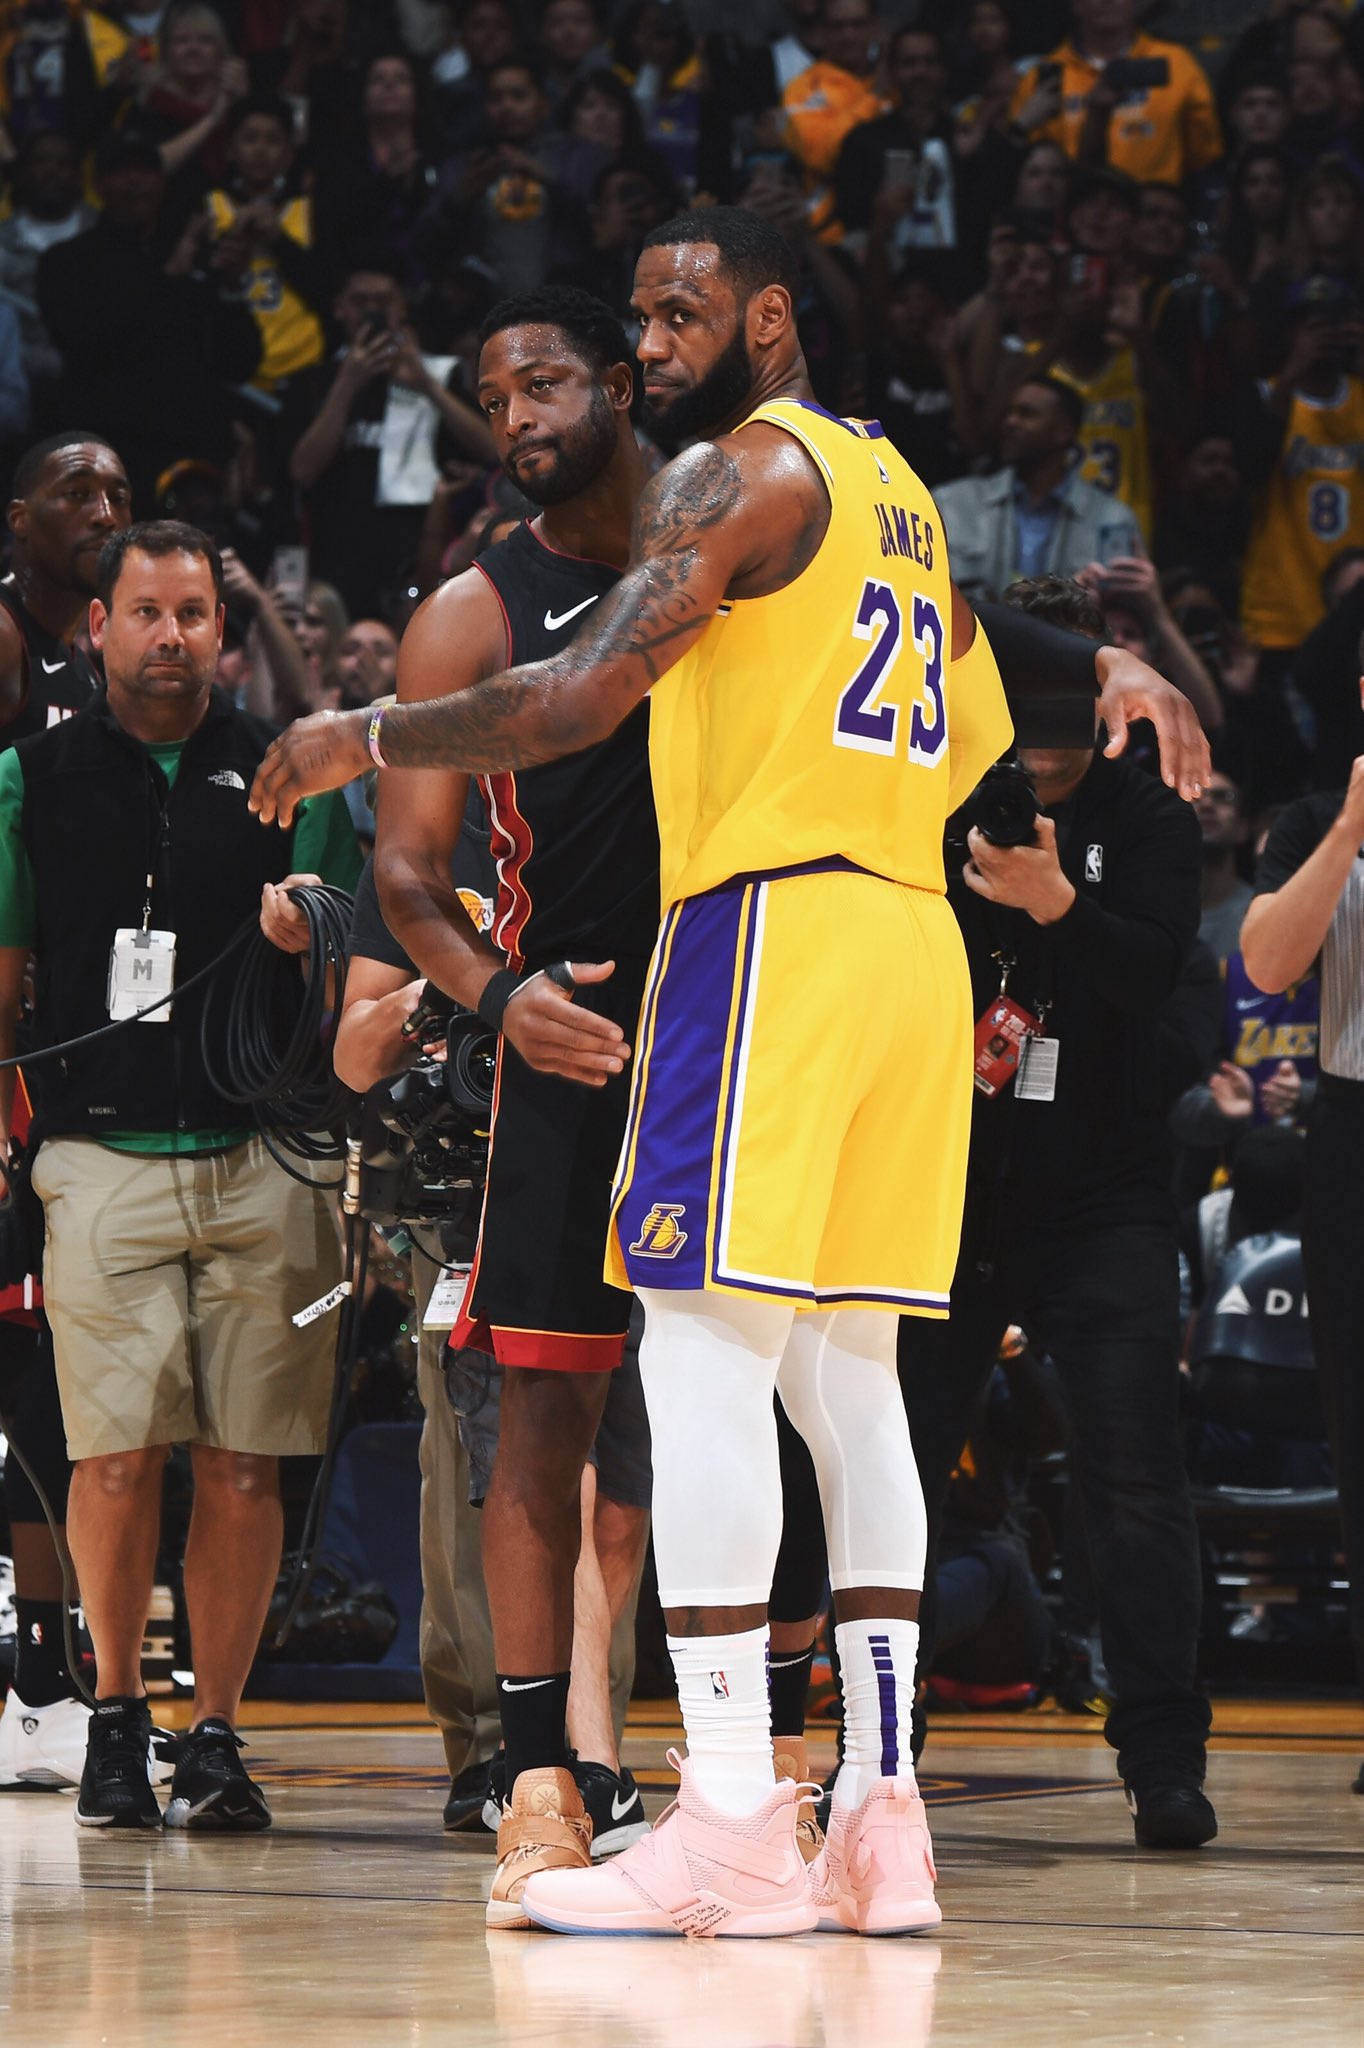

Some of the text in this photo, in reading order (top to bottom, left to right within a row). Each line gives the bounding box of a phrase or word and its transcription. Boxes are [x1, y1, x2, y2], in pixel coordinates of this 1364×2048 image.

[1307, 480, 1351, 543] 8
[874, 502, 934, 572] JAMES
[832, 576, 950, 769] 23
[208, 774, 235, 782] NORTH
[215, 779, 235, 787] FACE
[132, 958, 153, 981] M
